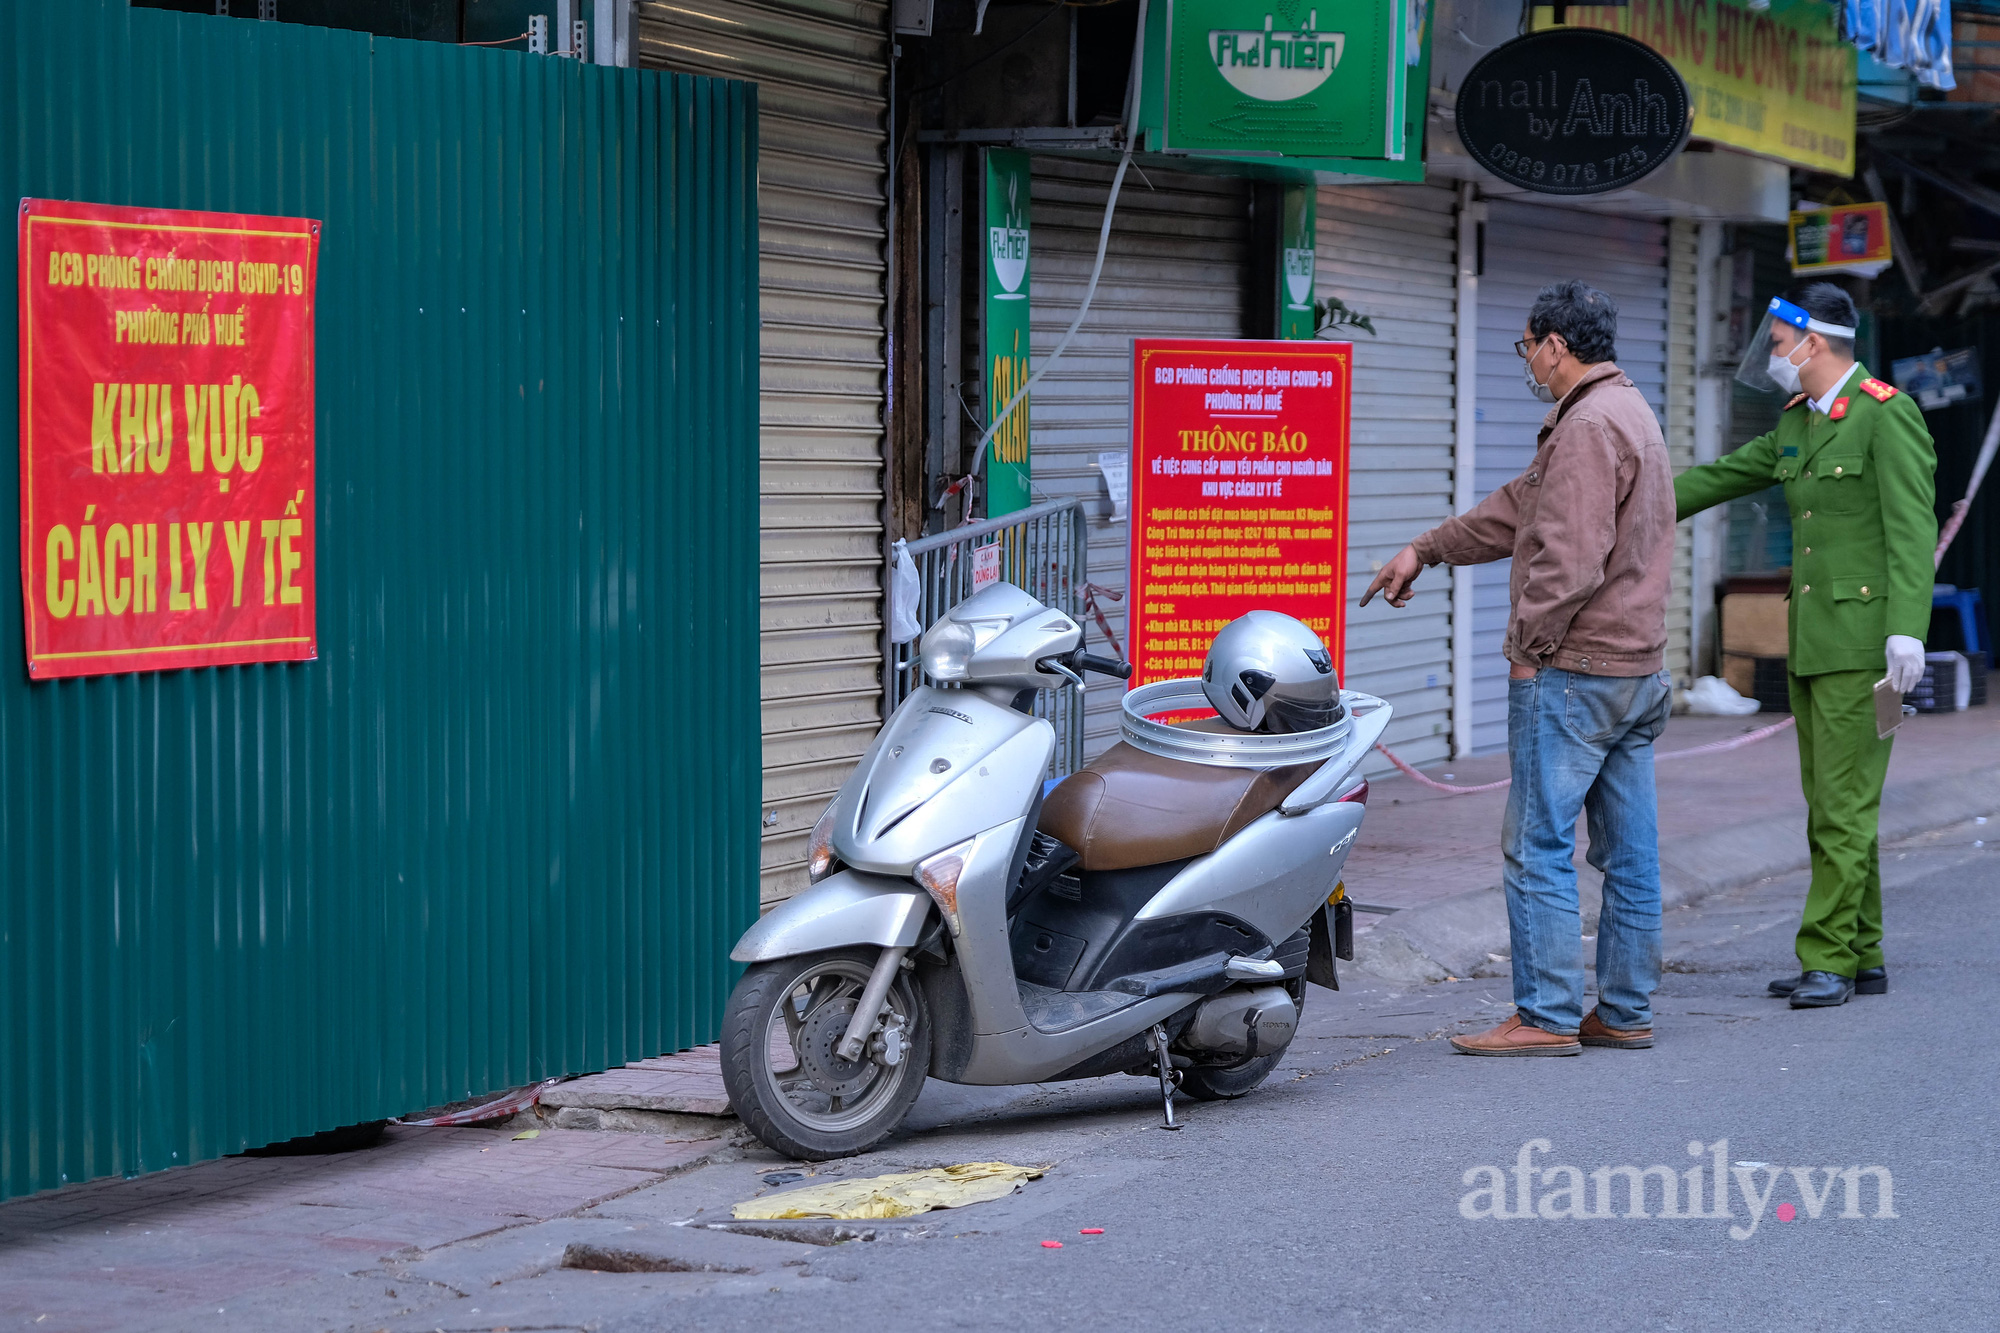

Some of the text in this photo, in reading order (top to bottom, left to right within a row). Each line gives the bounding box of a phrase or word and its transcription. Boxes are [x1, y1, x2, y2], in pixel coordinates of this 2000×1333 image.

[1480, 70, 1559, 109] nail
[1528, 112, 1559, 141] by
[1562, 77, 1671, 137] Anh
[48, 246, 303, 299] BCĐ PHÒNG CHỐNG DỊCH COVID-19
[115, 301, 245, 346] PHƯỜNG PHỐ HUẾ
[1155, 363, 1333, 390] BCĐ PHÒNG CHỐNG DỊCH BỆNH COVID-19
[1204, 388, 1283, 411] PHƯỜNG PHỐ HUẾ
[90, 375, 264, 494] KHU VỰC
[1178, 424, 1308, 453] THÔNG BÁO
[1163, 456, 1180, 478] VIỆC
[1181, 460, 1202, 475] CUNG
[1203, 455, 1219, 475] CẤP
[1220, 460, 1236, 475] NHU
[1237, 456, 1252, 475] YẾU
[1276, 460, 1291, 475] CHO
[1292, 457, 1315, 475] NGƯỜI
[1316, 458, 1333, 475] DÂN
[1202, 481, 1218, 496] KHU
[1219, 480, 1234, 500] VỰC
[1235, 479, 1256, 496] CÁCH
[1256, 481, 1266, 496] LY
[1273, 477, 1282, 497] TẾ
[45, 489, 305, 619] CÁCH LY Y TẾ
